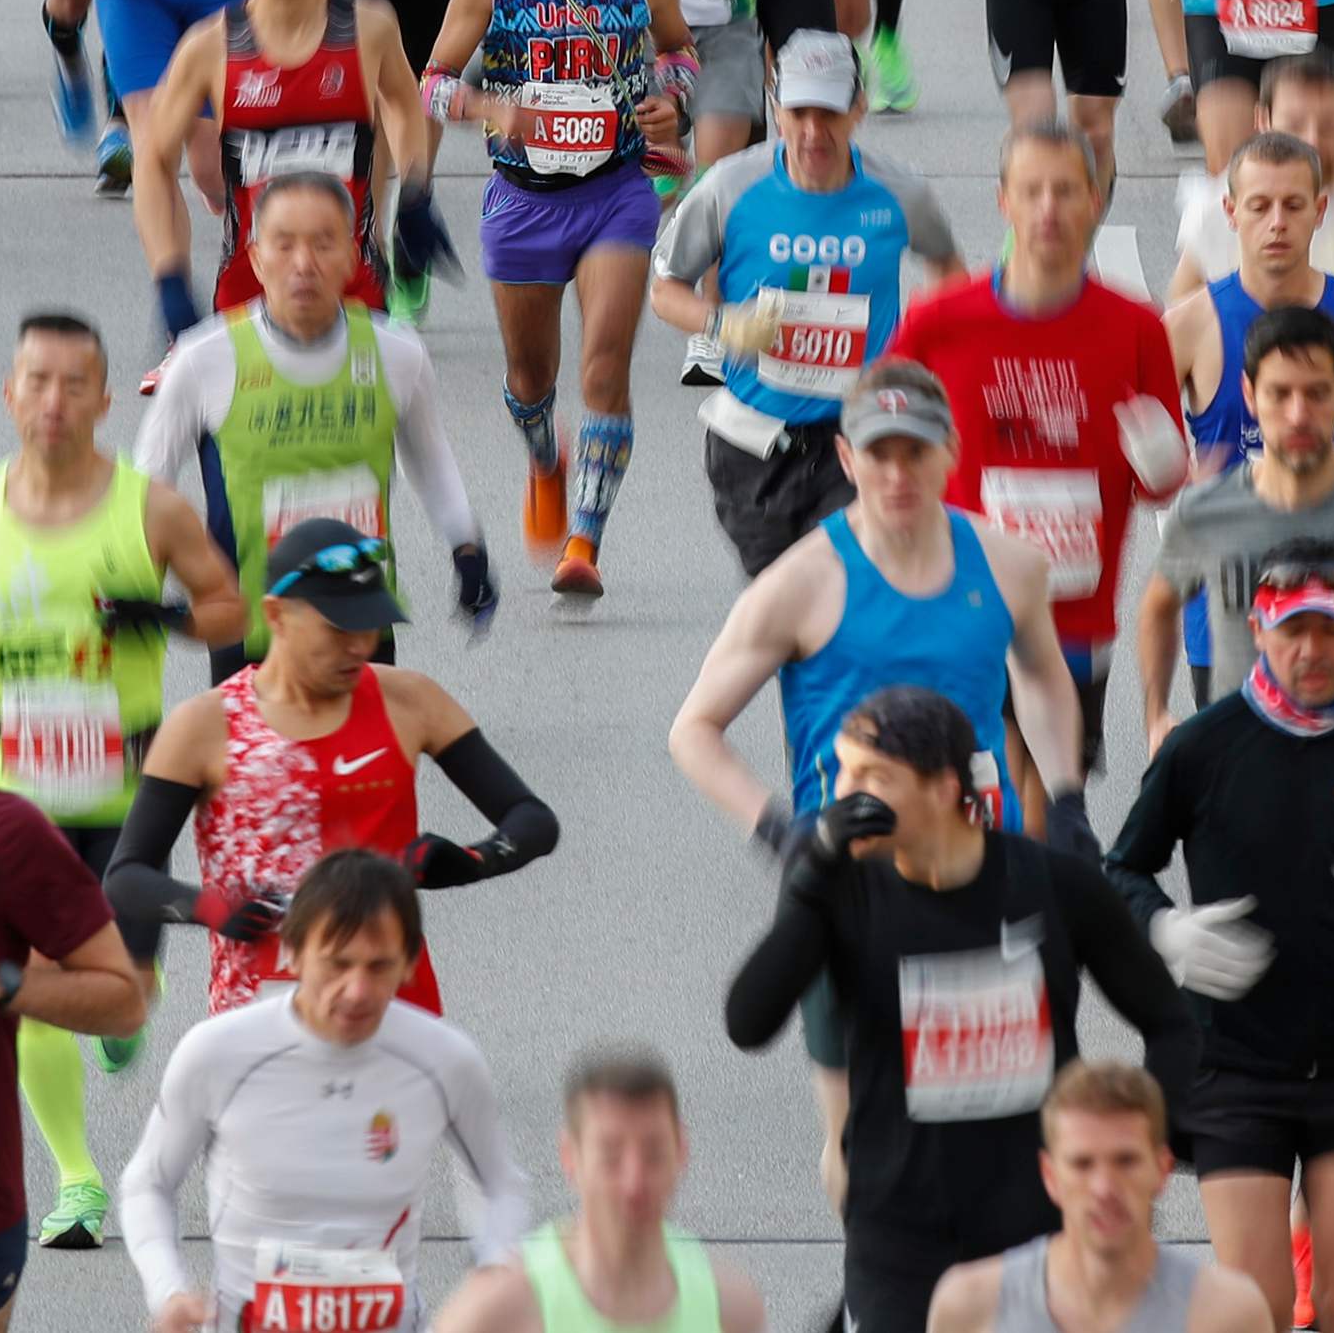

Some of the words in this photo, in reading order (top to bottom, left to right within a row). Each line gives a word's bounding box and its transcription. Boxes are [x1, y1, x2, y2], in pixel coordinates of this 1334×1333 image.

[528, 35, 620, 83] PERU
[534, 117, 547, 142] A
[552, 116, 605, 144] 5086
[262, 1287, 288, 1331] A
[296, 1286, 395, 1331] 18177
